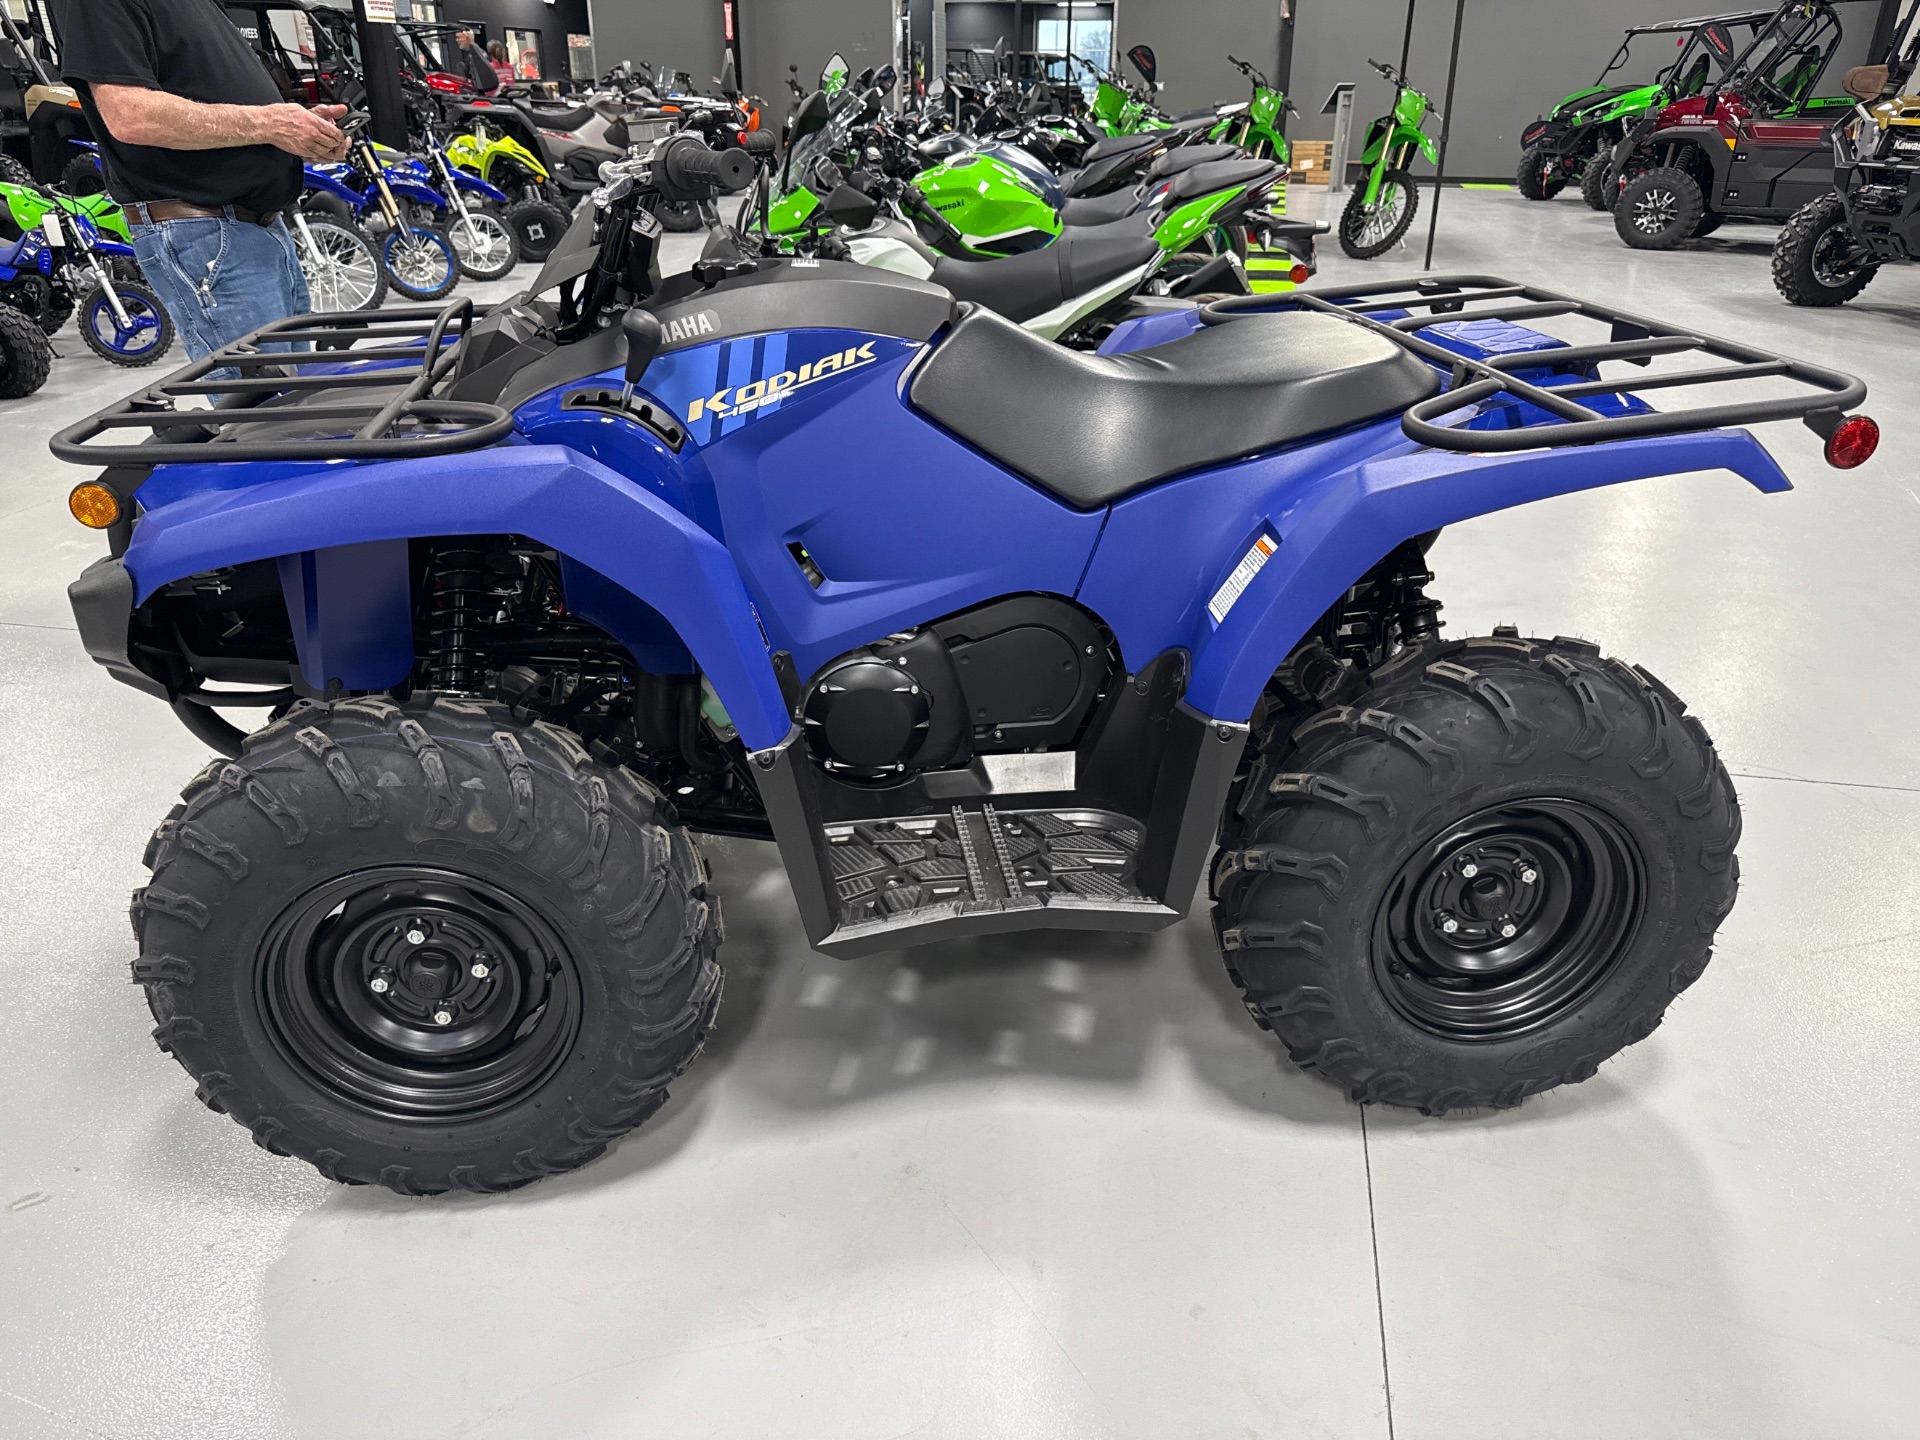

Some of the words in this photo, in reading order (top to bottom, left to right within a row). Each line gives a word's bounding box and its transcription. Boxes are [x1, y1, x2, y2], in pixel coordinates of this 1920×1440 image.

[935, 199, 965, 212] wasaki
[660, 313, 714, 344] MAHA
[687, 340, 877, 423] KODIAK
[415, 838, 551, 892] CST
